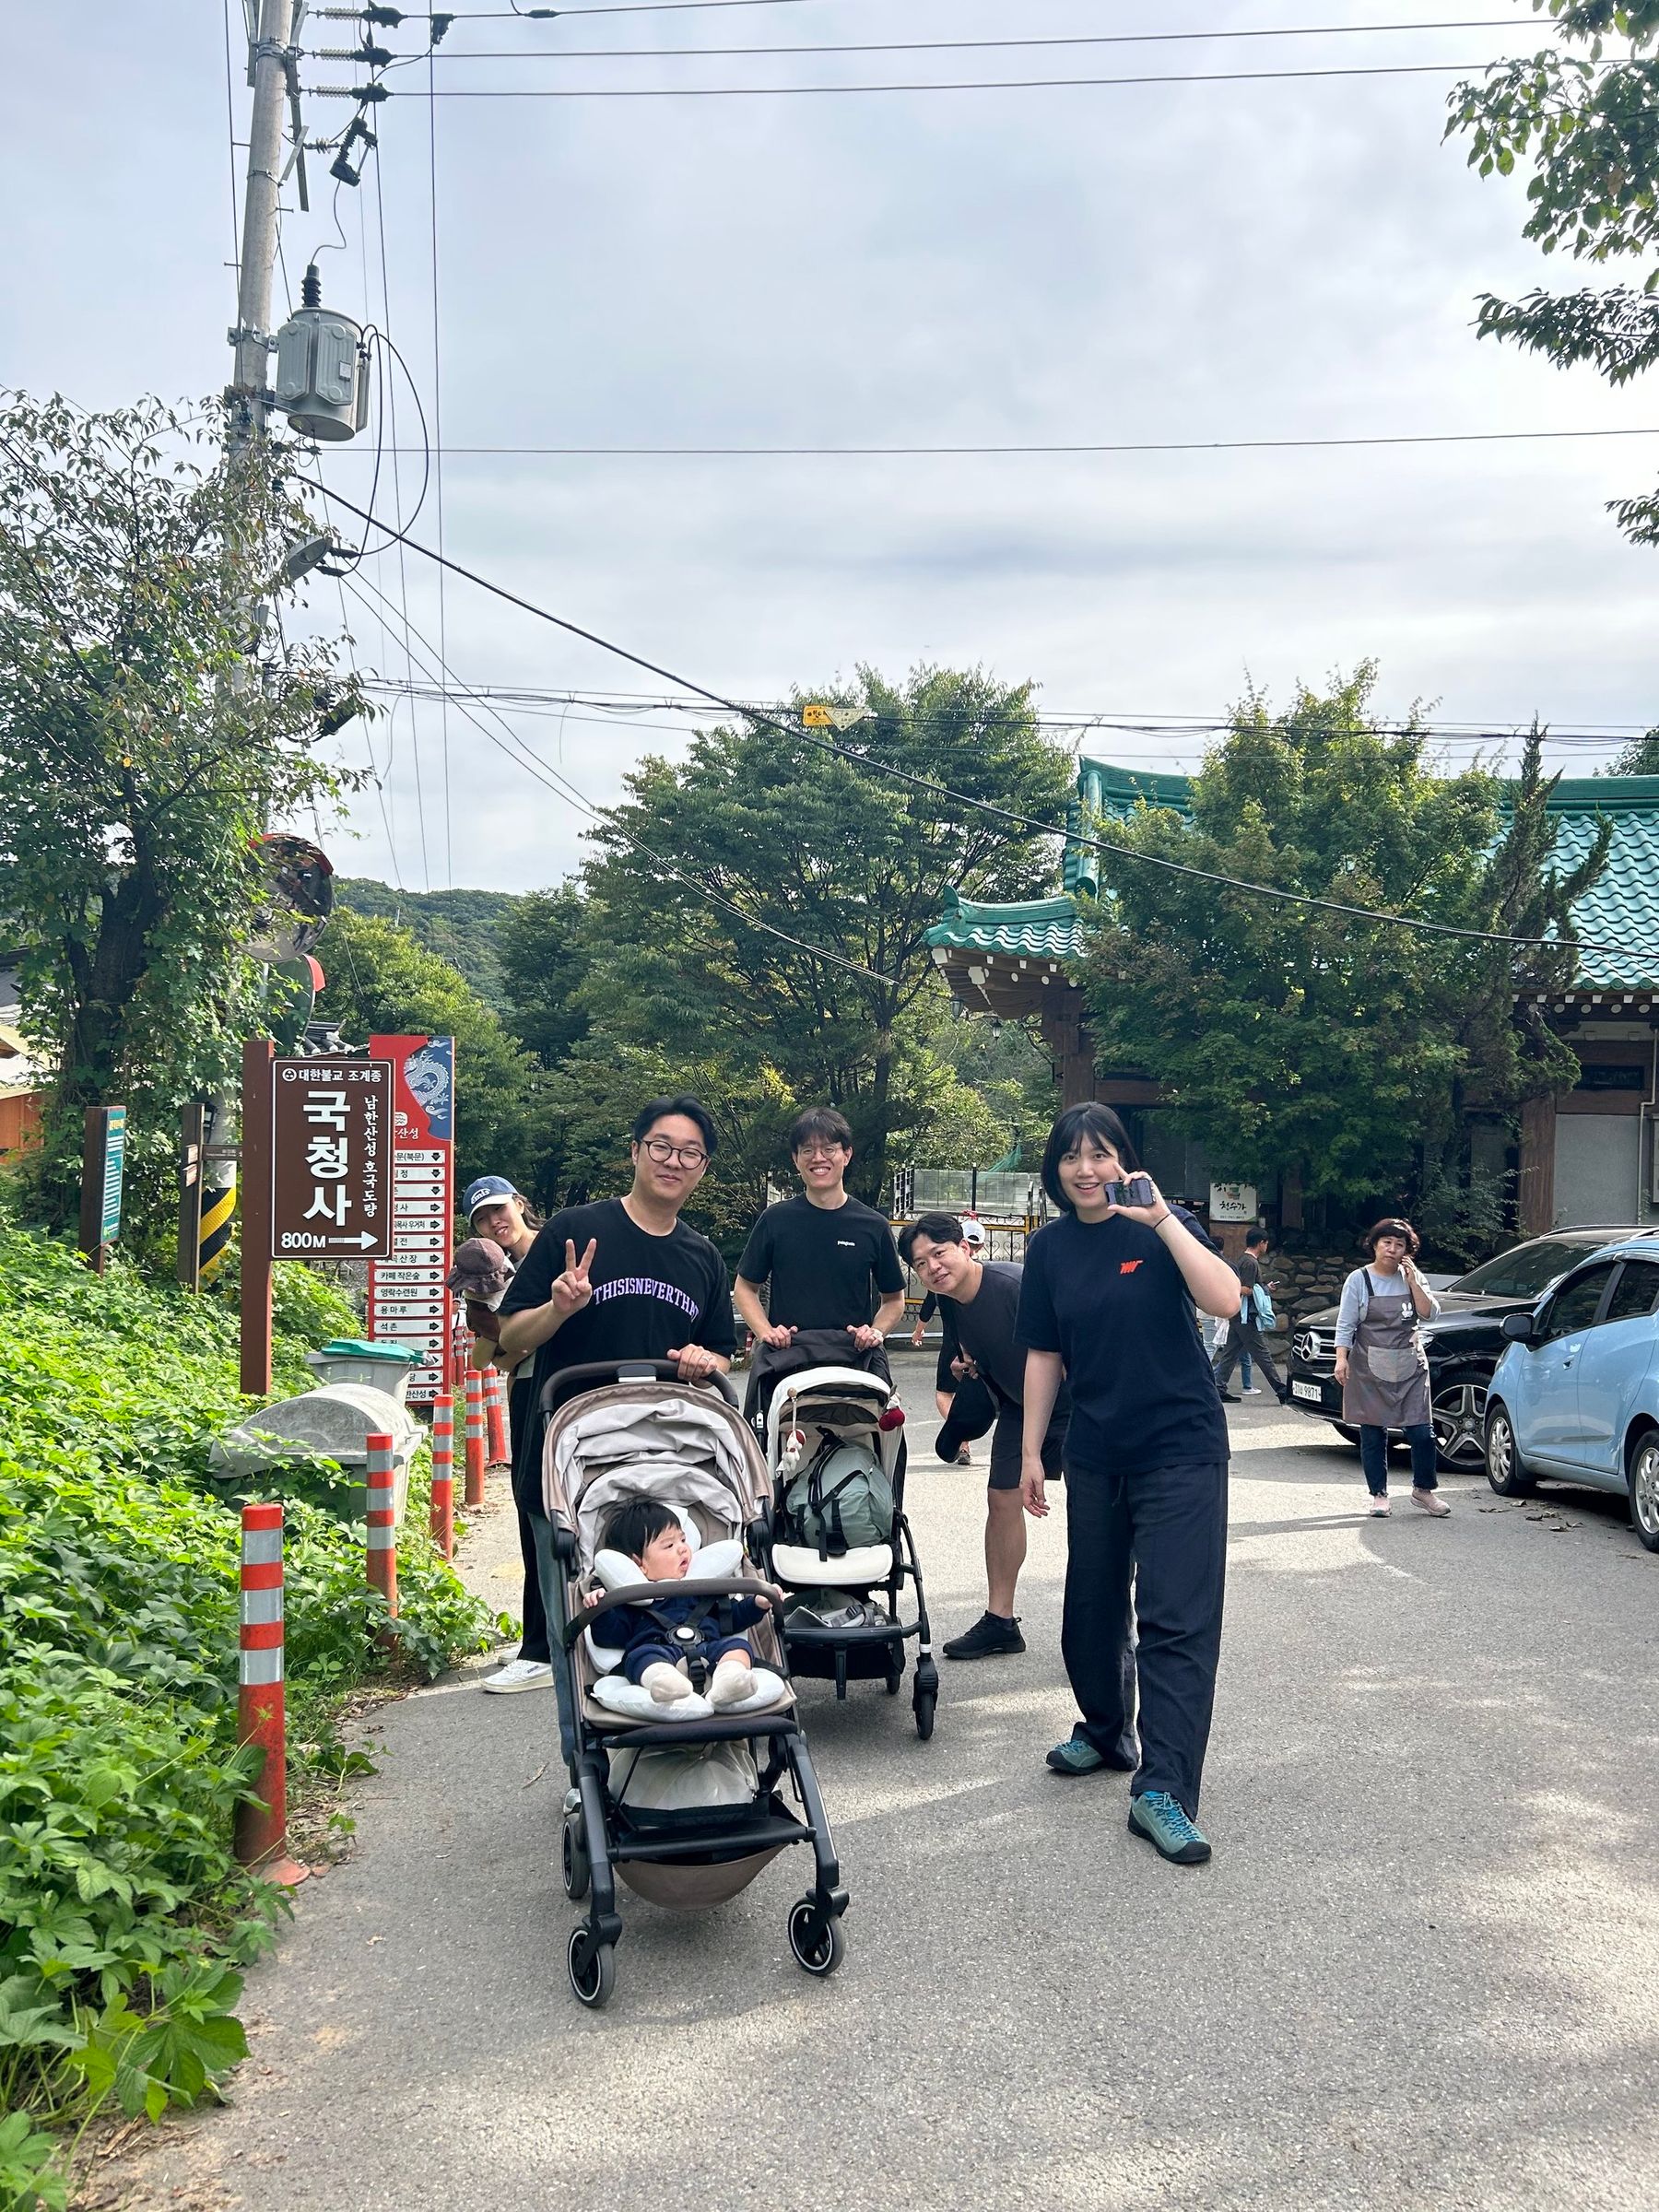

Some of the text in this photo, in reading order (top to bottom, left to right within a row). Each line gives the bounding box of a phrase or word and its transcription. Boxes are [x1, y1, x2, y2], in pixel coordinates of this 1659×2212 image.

[299, 1069, 382, 1083] 대한불교 조계종
[302, 1091, 352, 1227] 국청사
[362, 1094, 379, 1218] 남한산성 호국도량
[281, 1231, 326, 1249] 800M
[381, 1271, 395, 1280] 카페
